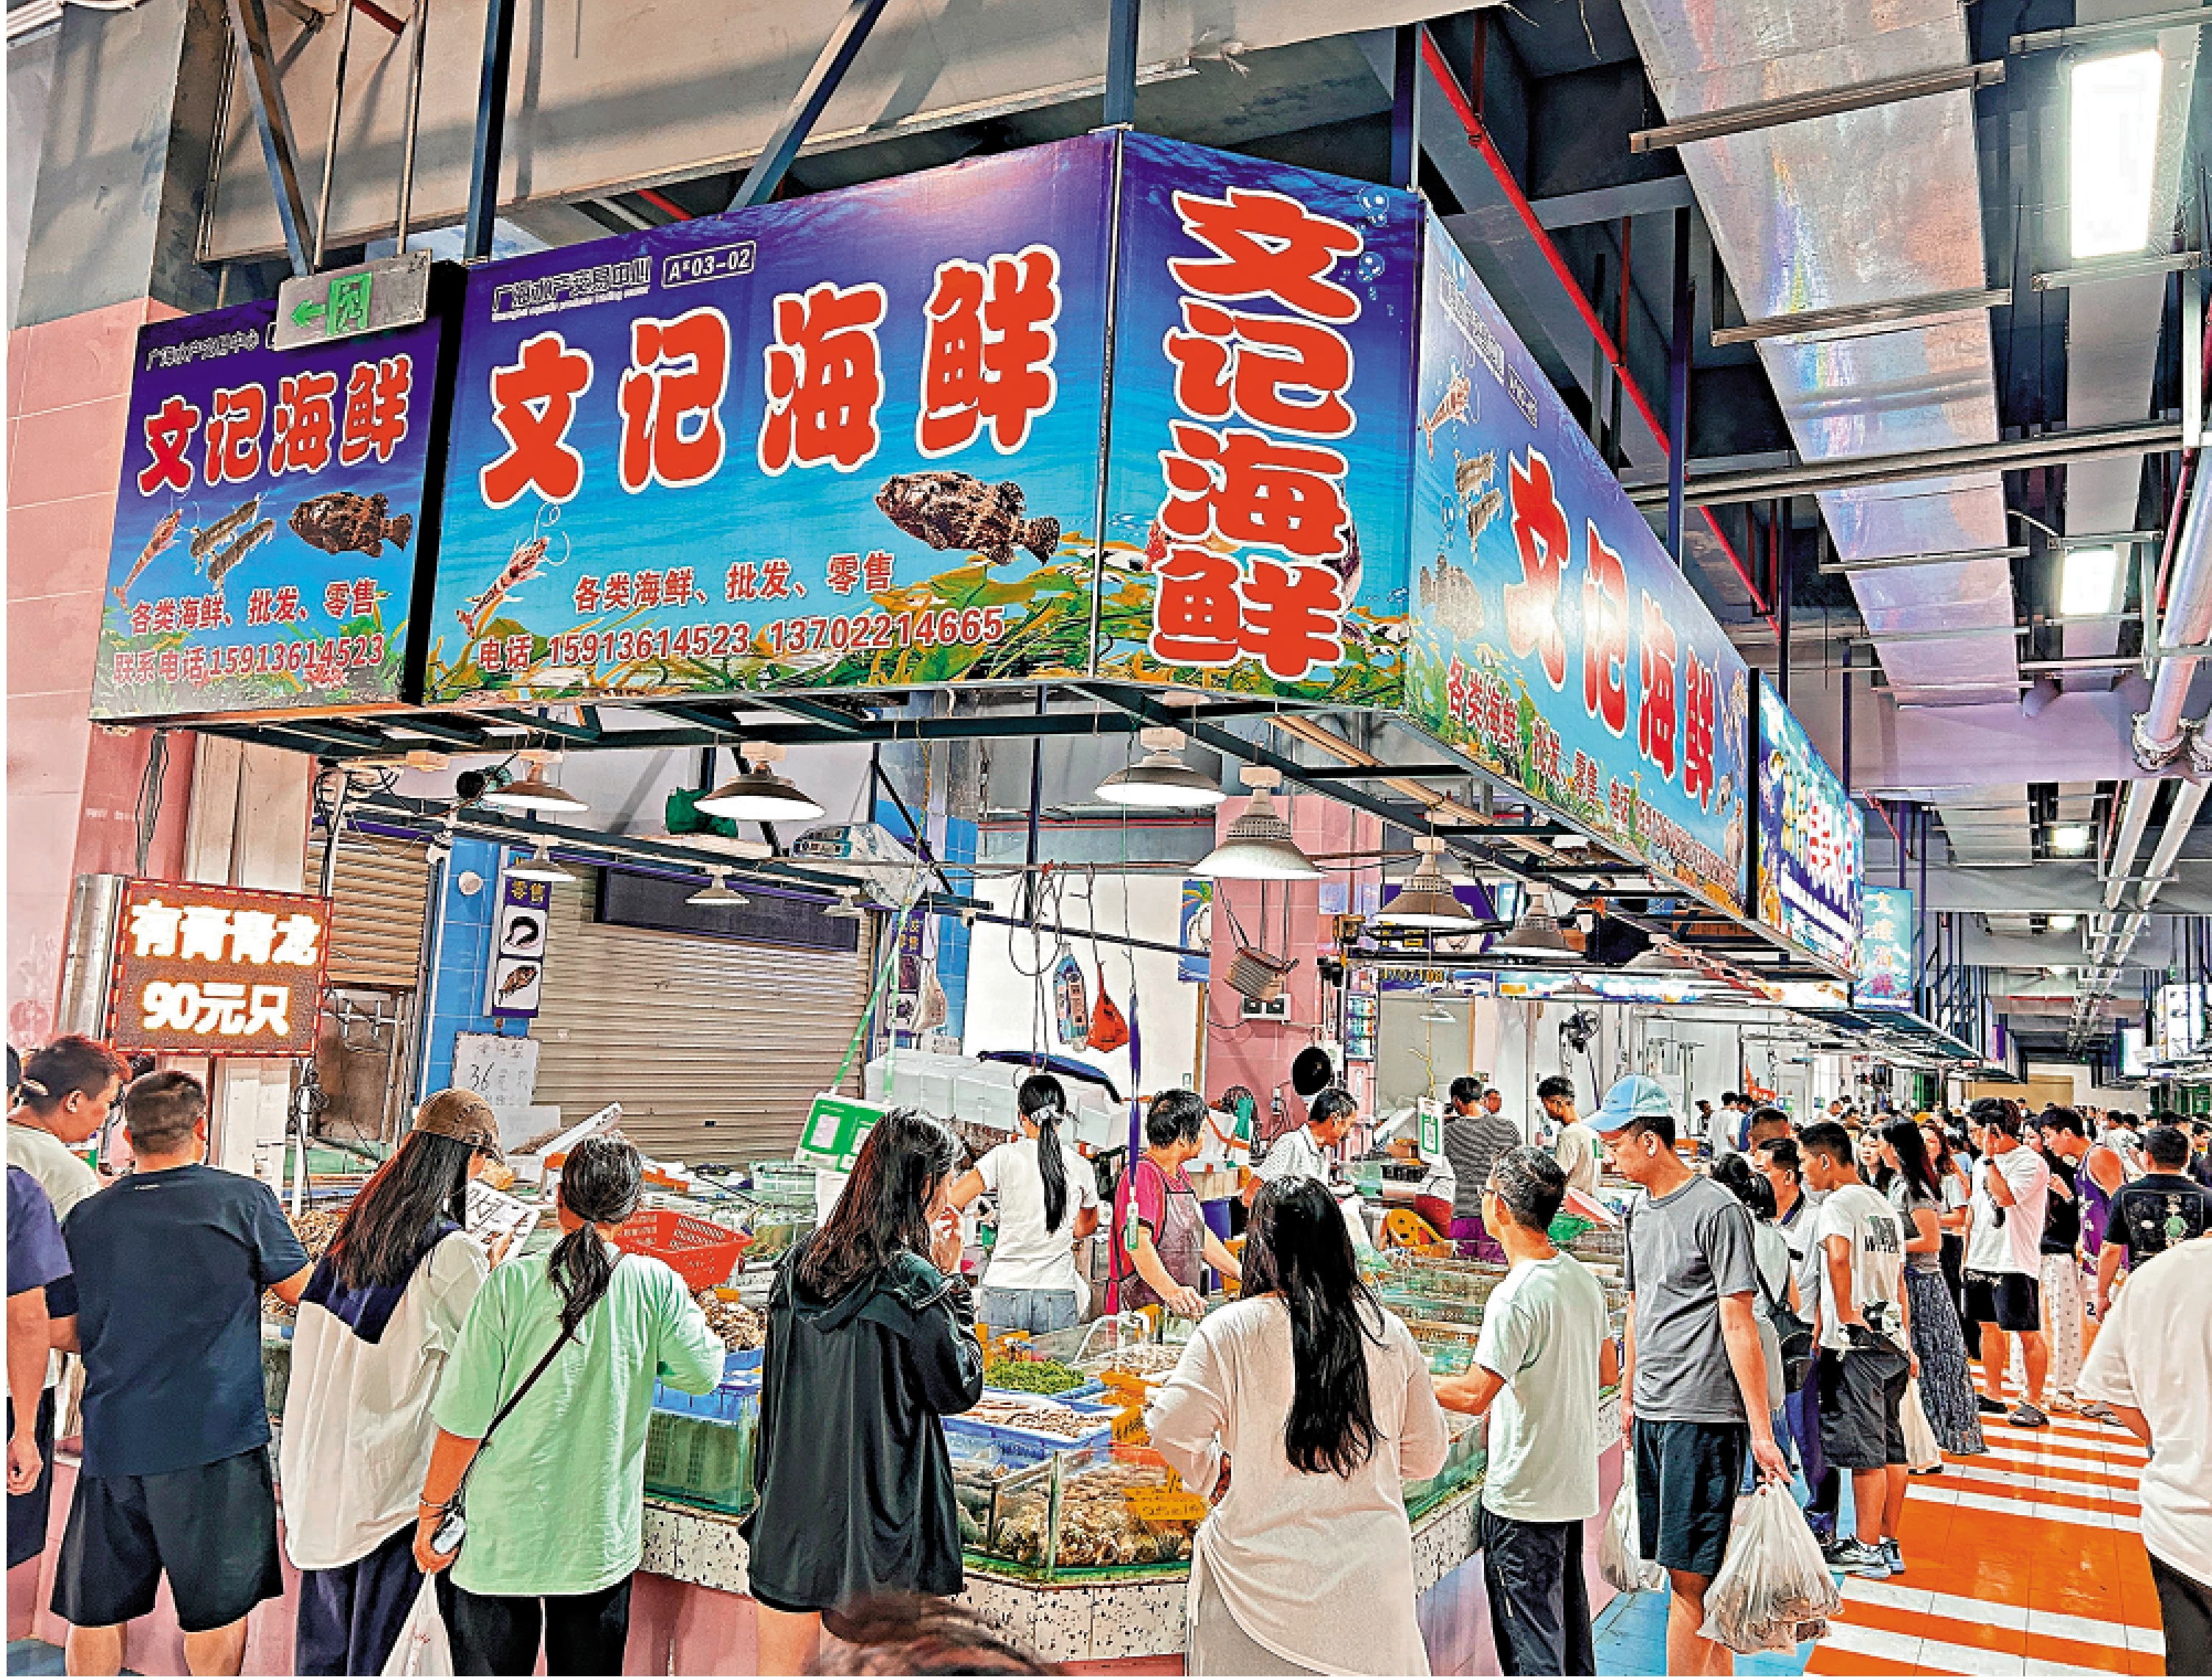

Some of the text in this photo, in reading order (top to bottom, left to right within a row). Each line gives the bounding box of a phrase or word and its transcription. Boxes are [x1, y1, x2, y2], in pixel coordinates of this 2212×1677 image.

[137, 354, 413, 496] 文记海鲜
[479, 244, 1060, 509] 文记海鲜
[1147, 186, 1364, 681] 文记海鲜
[478, 606, 1005, 672] 电话 15913614523 13702214665
[1503, 444, 1717, 814] 文记海鲜
[142, 981, 291, 1036] 90元只
